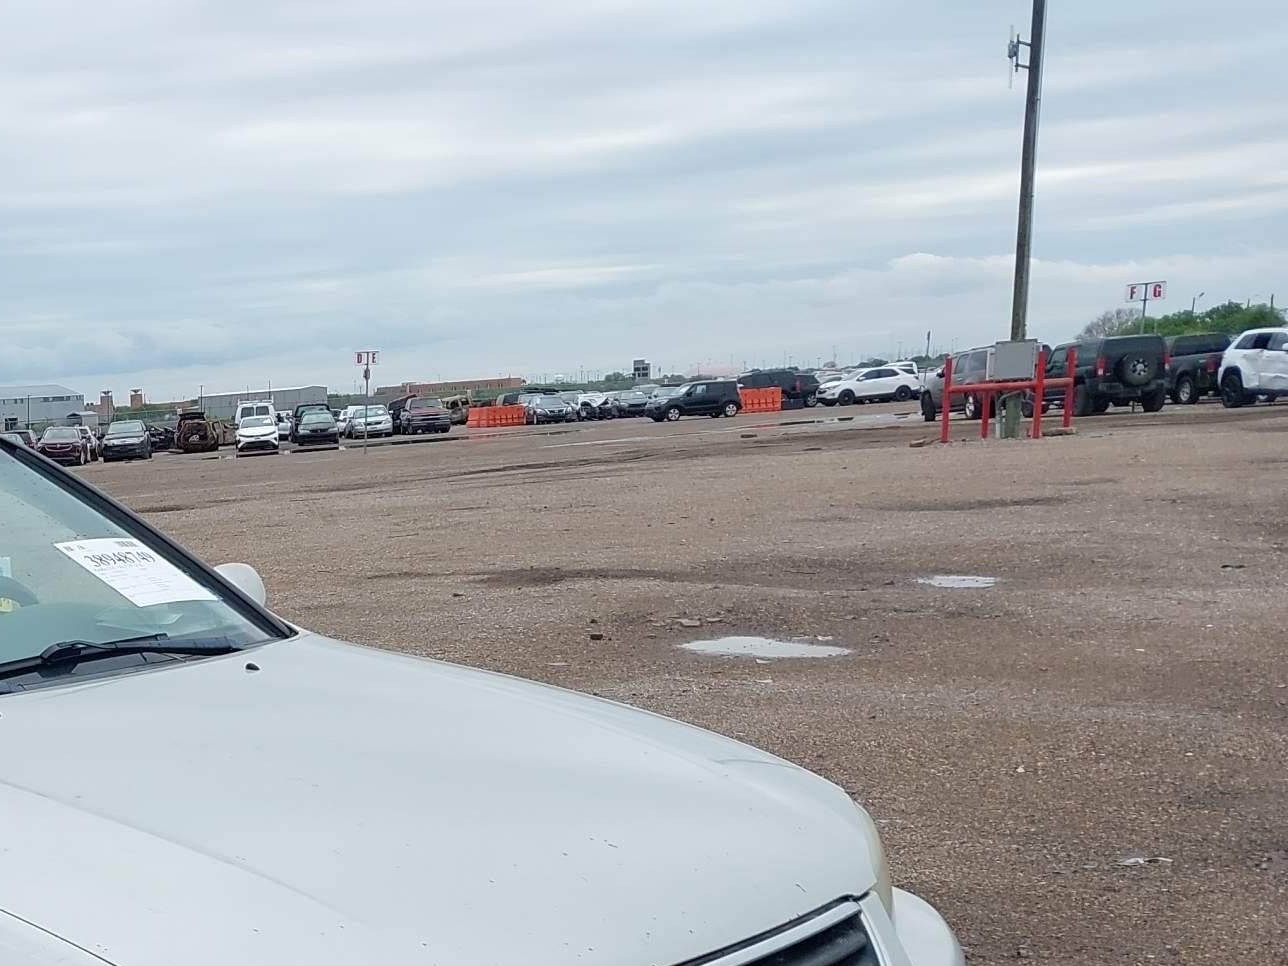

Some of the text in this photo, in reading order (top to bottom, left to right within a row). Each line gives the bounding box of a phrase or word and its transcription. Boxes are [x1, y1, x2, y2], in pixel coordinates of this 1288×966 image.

[1129, 284, 1161, 300] F G
[372, 352, 377, 364] E
[83, 551, 157, 568] 38948749
